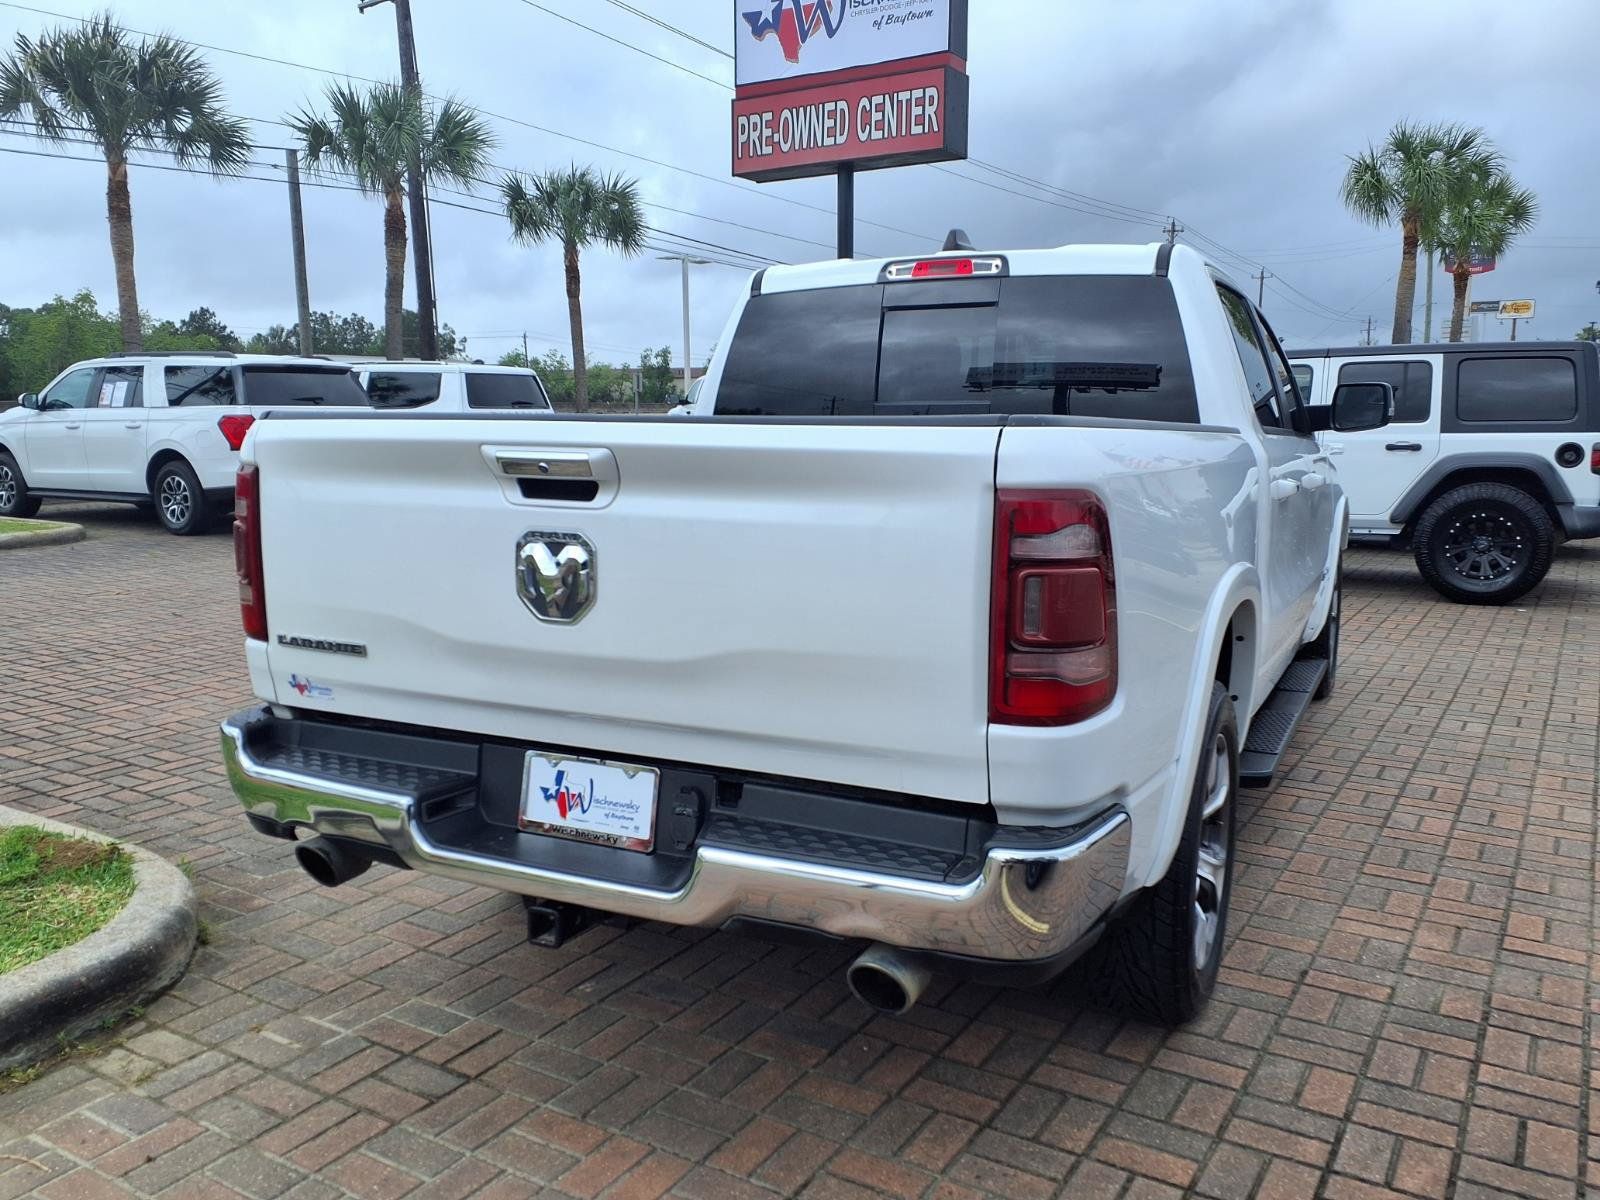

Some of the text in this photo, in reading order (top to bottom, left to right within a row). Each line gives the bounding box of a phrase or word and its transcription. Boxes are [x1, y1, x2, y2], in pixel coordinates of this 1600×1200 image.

[872, 9, 934, 30] of Baytown
[737, 86, 940, 159] PRE-OWNED CENTER
[552, 825, 618, 845] Wischnewsky
